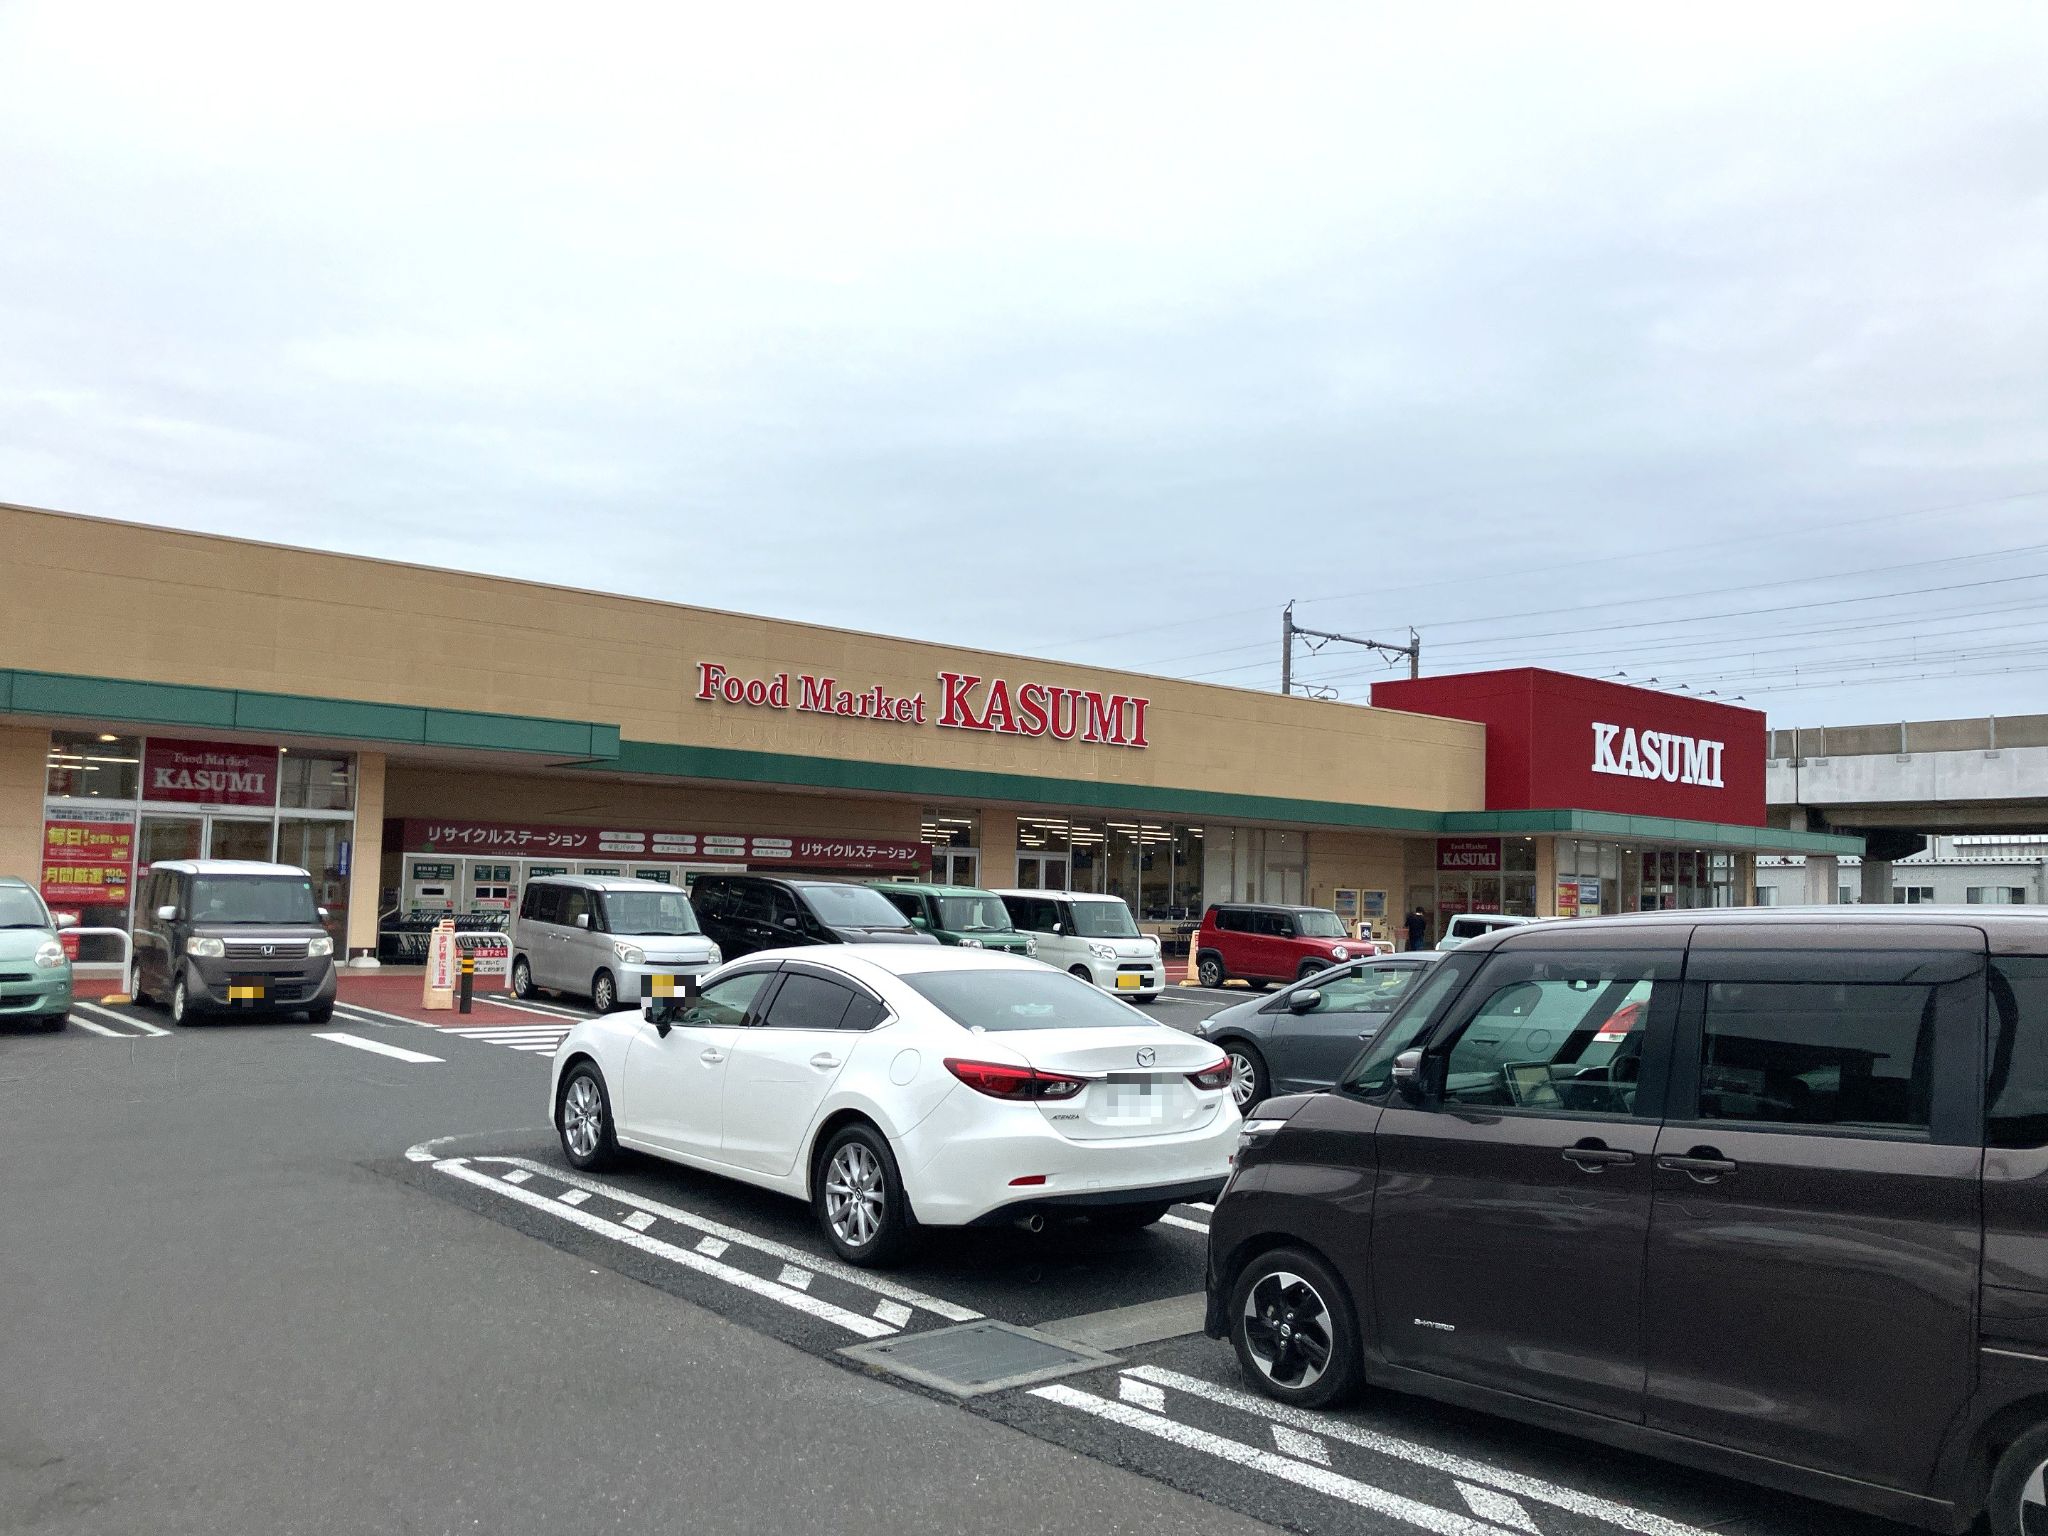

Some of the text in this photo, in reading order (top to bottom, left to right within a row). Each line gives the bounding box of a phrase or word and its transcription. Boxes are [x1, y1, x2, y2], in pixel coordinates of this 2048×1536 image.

[695, 661, 1151, 749] Food Market KASUMI
[173, 751, 250, 768] Food Market
[1591, 721, 1725, 789] KASUMI
[153, 767, 266, 795] KASUMI
[428, 825, 588, 848] リサイクルステーション
[800, 842, 918, 860] リサイクルステーション
[1443, 853, 1497, 866] KASUMI
[438, 935, 448, 985] 歩行者に注意
